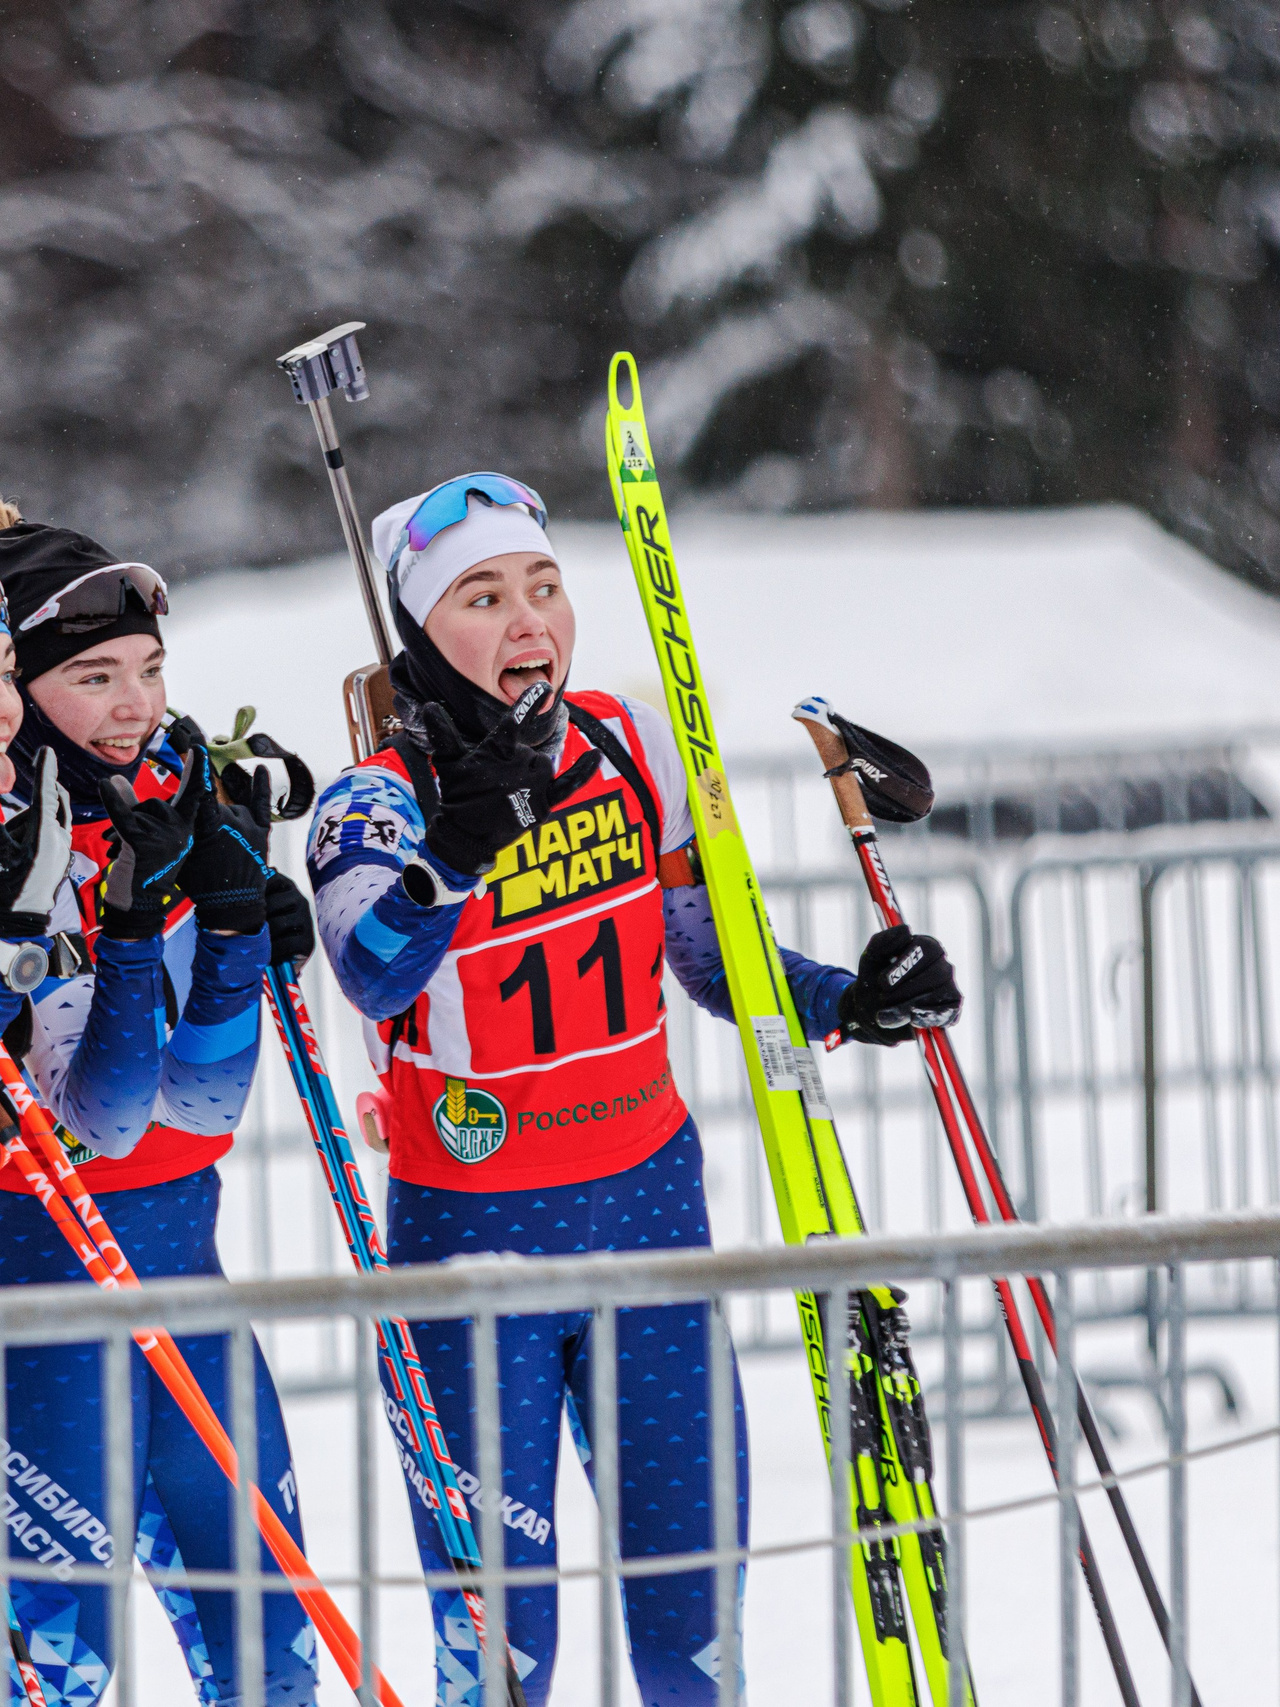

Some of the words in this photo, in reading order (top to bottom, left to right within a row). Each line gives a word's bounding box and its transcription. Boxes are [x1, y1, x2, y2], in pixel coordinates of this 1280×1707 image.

[636, 504, 713, 776] FISCHER
[852, 757, 888, 783] SWIX
[484, 800, 626, 884] ПАРИ
[501, 832, 642, 918] МАТЧ
